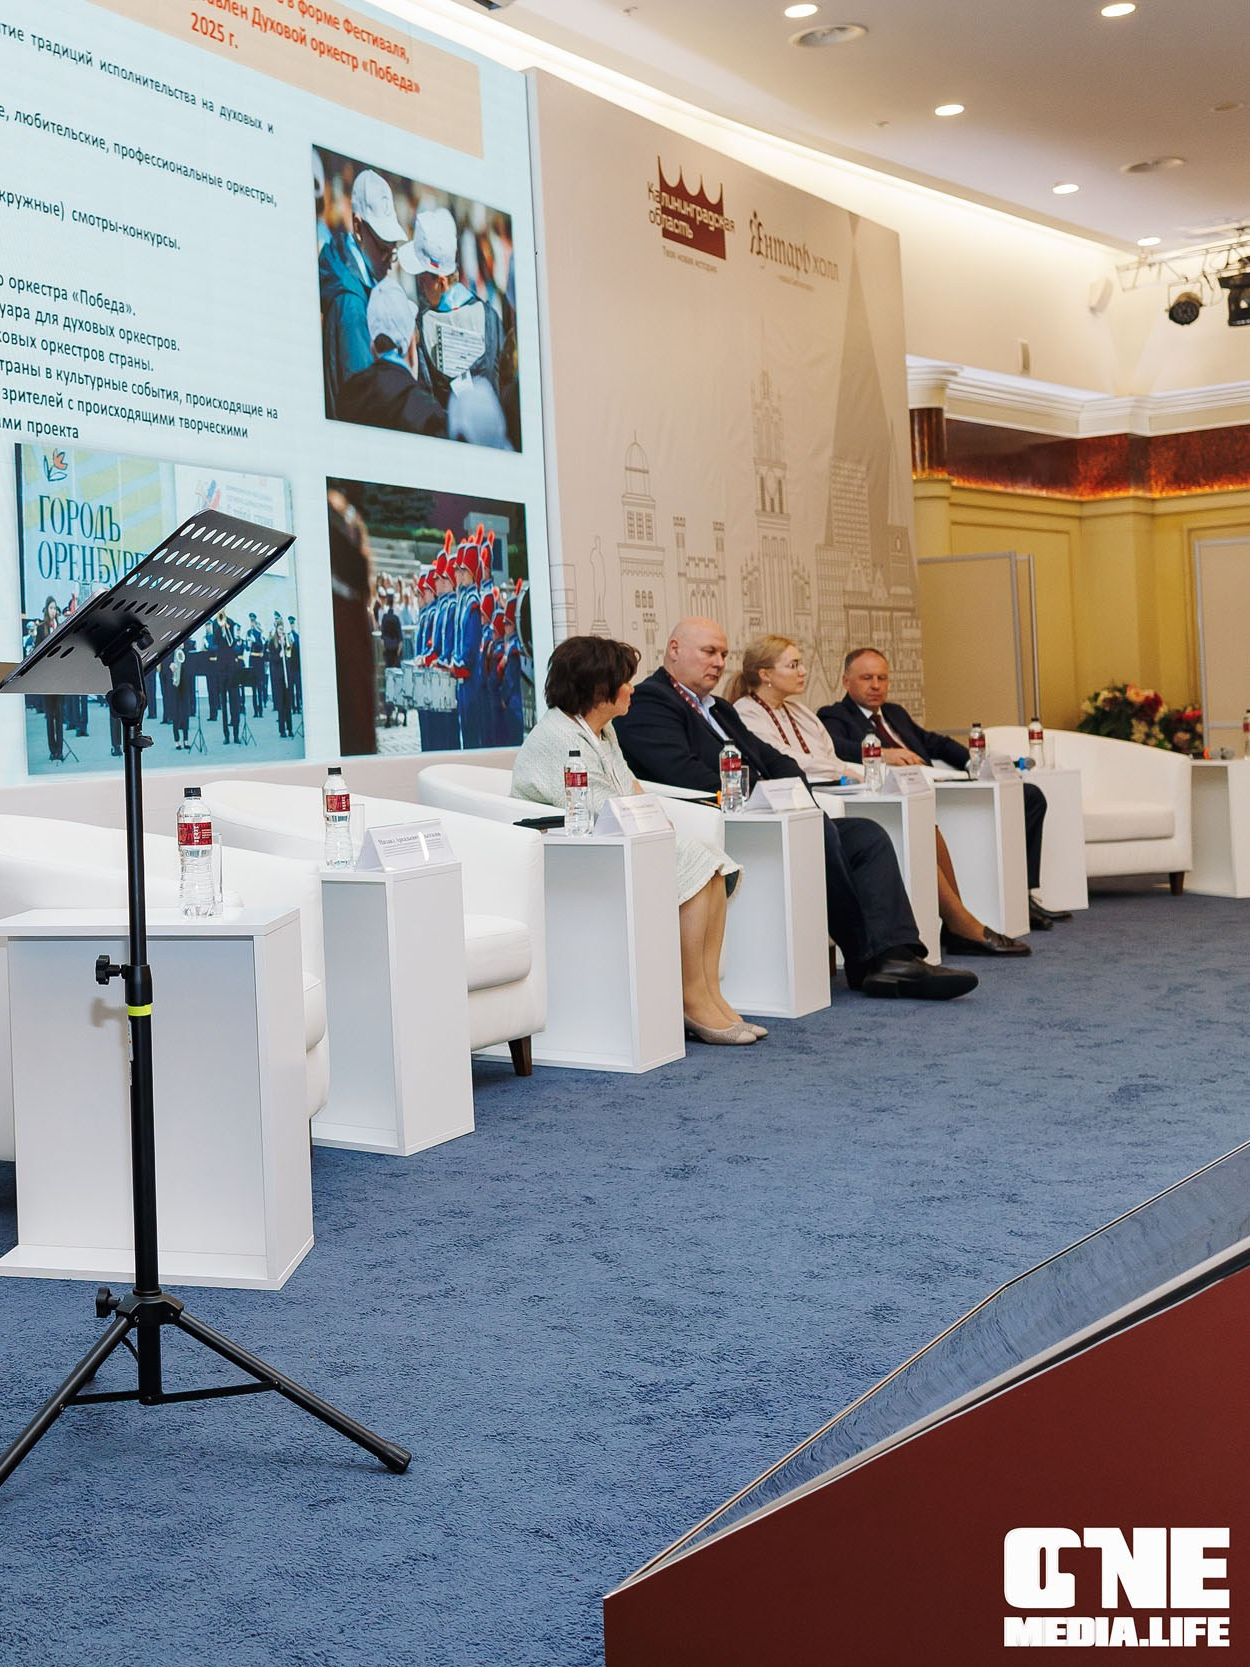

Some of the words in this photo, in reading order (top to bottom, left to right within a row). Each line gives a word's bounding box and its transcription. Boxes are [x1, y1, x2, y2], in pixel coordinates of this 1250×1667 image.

[191, 12, 224, 42] 2025
[229, 33, 238, 48] г.
[252, 7, 307, 46] Духовой
[311, 38, 358, 72] оркестр
[362, 59, 420, 93] «Победа»
[343, 18, 409, 63] Фестиваля,
[31, 34, 92, 66] традиций
[100, 61, 196, 105] исполнительства
[202, 99, 214, 112] на
[220, 106, 262, 129] духовых
[268, 124, 273, 133] и
[15, 111, 109, 153] любительские,
[114, 143, 223, 187] профессиональные
[227, 177, 276, 207] оркестры,
[72, 210, 180, 249] смотры-конкурсы.
[9, 277, 67, 302] оркестра
[72, 289, 135, 316] «Победа».
[35, 311, 58, 326] для
[63, 317, 115, 337] духовых
[119, 328, 180, 351] оркестров.
[41, 339, 104, 362] оркестров
[109, 353, 153, 371] страны.
[2, 388, 63, 408] зрителей
[68, 399, 73, 410] с
[78, 400, 175, 426] происходящими
[179, 417, 248, 438] творческими
[46, 367, 52, 378] в
[57, 370, 127, 392] культурные
[132, 382, 182, 405] события,
[186, 393, 263, 417] происходящие
[267, 408, 277, 419] на
[27, 421, 78, 438] проекта
[39, 495, 121, 544] ГОРОДЪ
